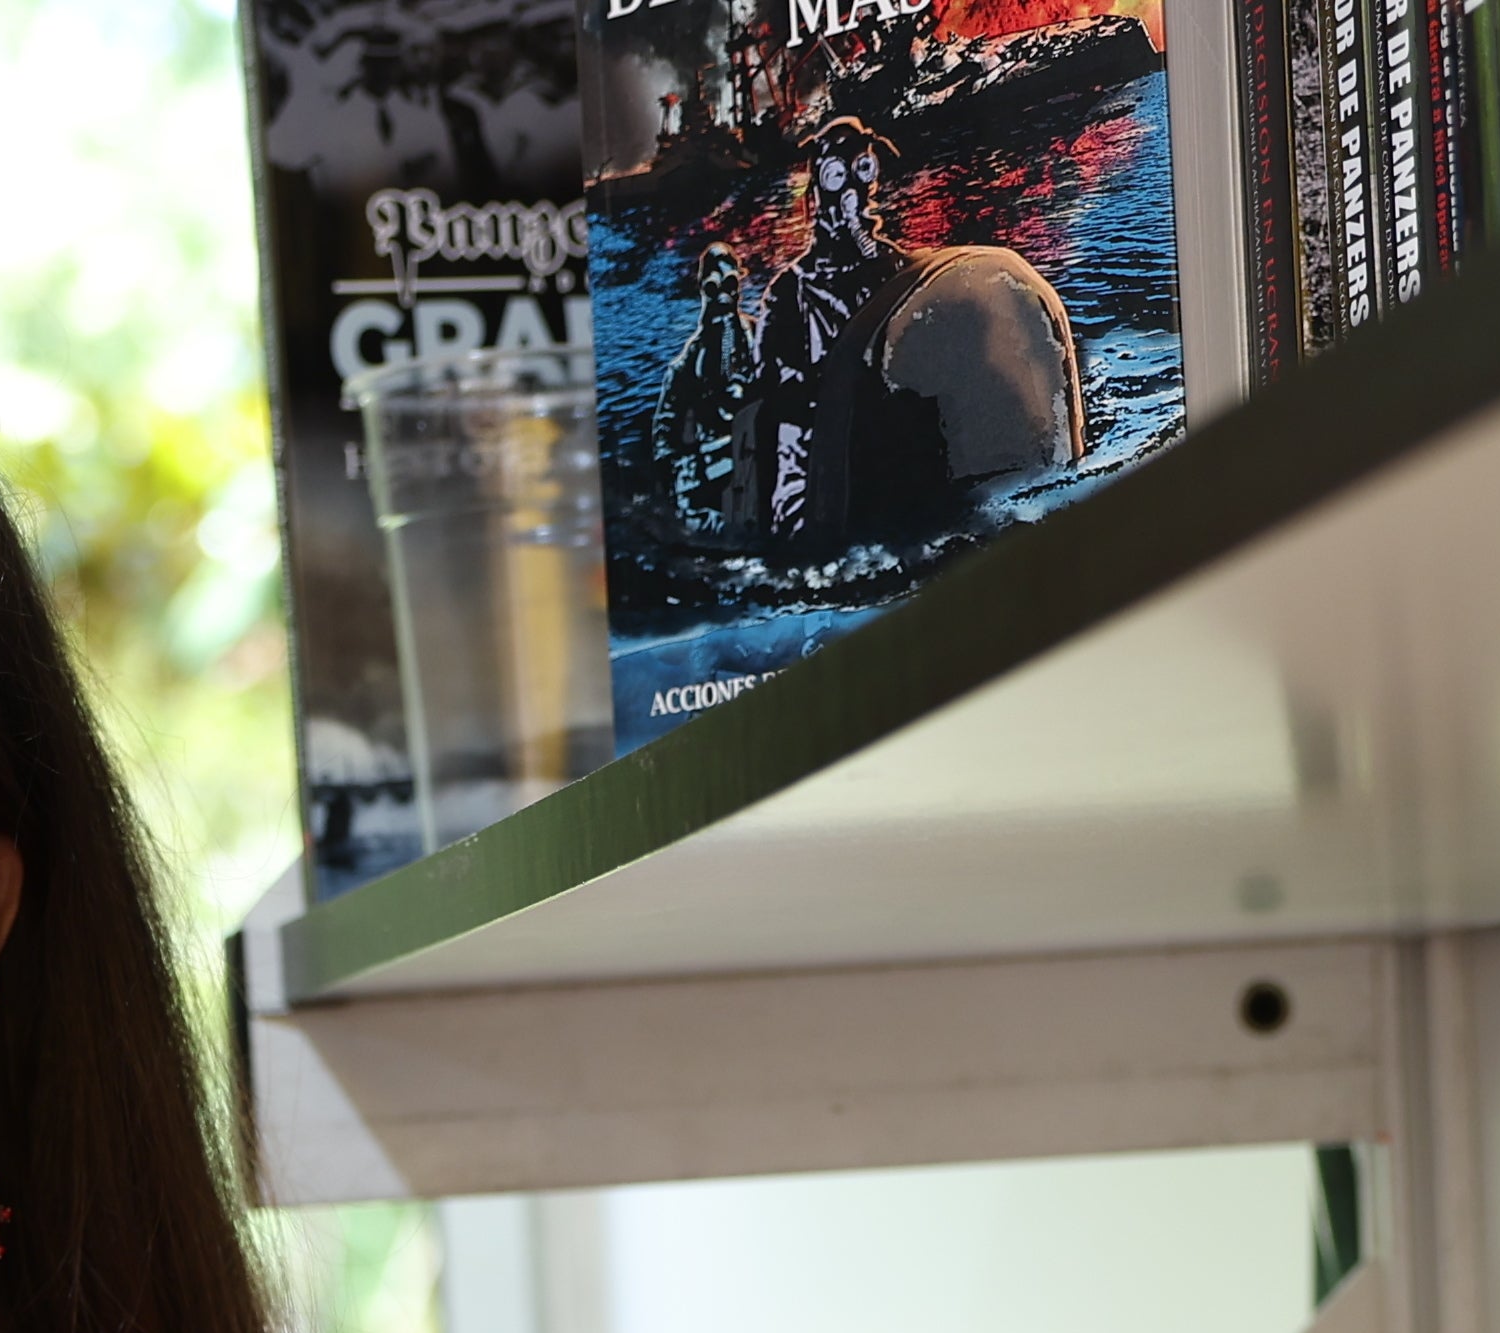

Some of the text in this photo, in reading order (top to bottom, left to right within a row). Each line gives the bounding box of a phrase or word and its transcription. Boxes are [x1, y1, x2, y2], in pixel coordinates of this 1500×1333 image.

[1337, 59, 1359, 122] DE
[1388, 29, 1411, 95] DE
[1342, 125, 1369, 328] PANZERS
[1391, 97, 1421, 303] PANZERS
